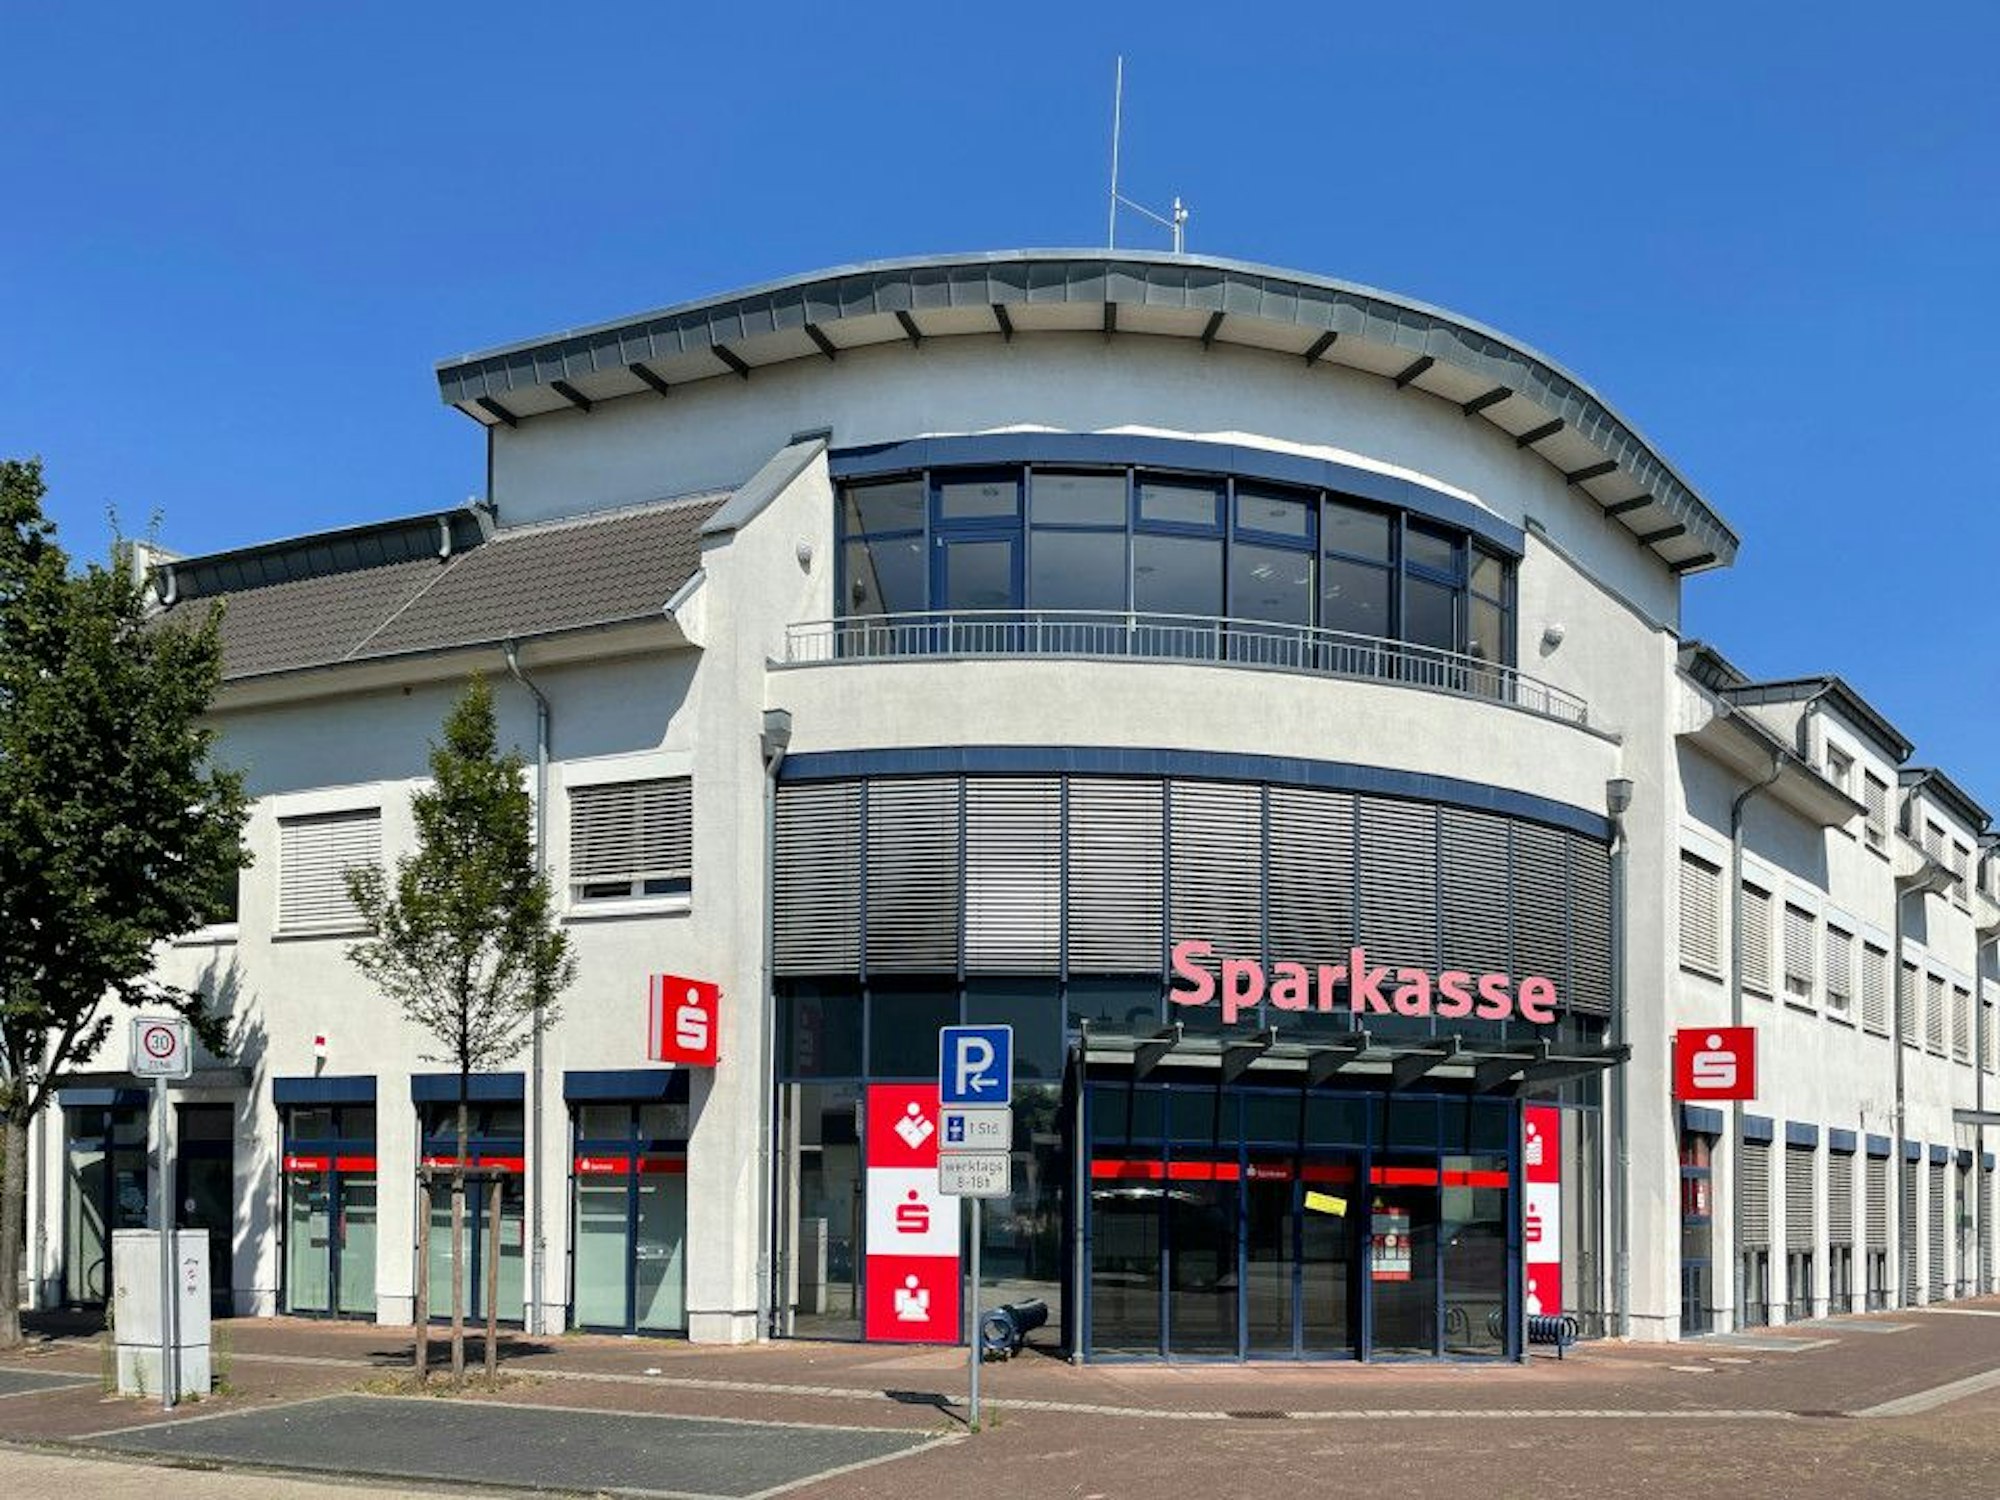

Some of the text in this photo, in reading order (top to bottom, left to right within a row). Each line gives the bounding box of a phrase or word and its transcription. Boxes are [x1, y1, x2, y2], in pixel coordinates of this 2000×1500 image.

[1170, 939, 1557, 1024] Sparkasse
[151, 1034, 169, 1051] 30
[956, 1037, 994, 1095] P
[945, 1160, 1002, 1175] werktags
